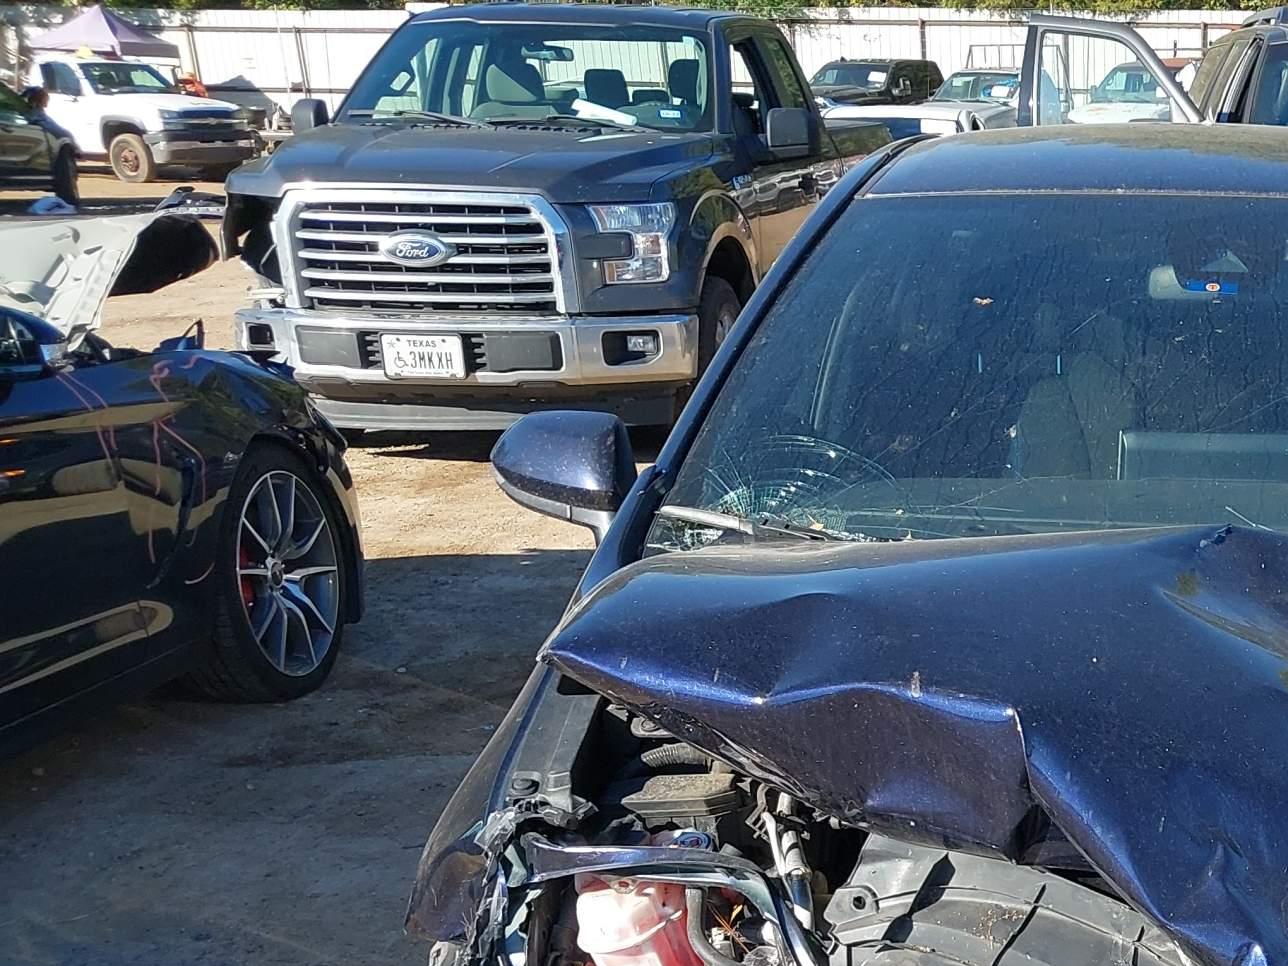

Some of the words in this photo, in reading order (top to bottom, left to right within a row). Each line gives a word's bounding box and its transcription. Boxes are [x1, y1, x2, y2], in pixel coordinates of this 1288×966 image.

[395, 241, 430, 258] Ford
[406, 339, 437, 348] TEXAS
[409, 351, 454, 370] 3MKXH
